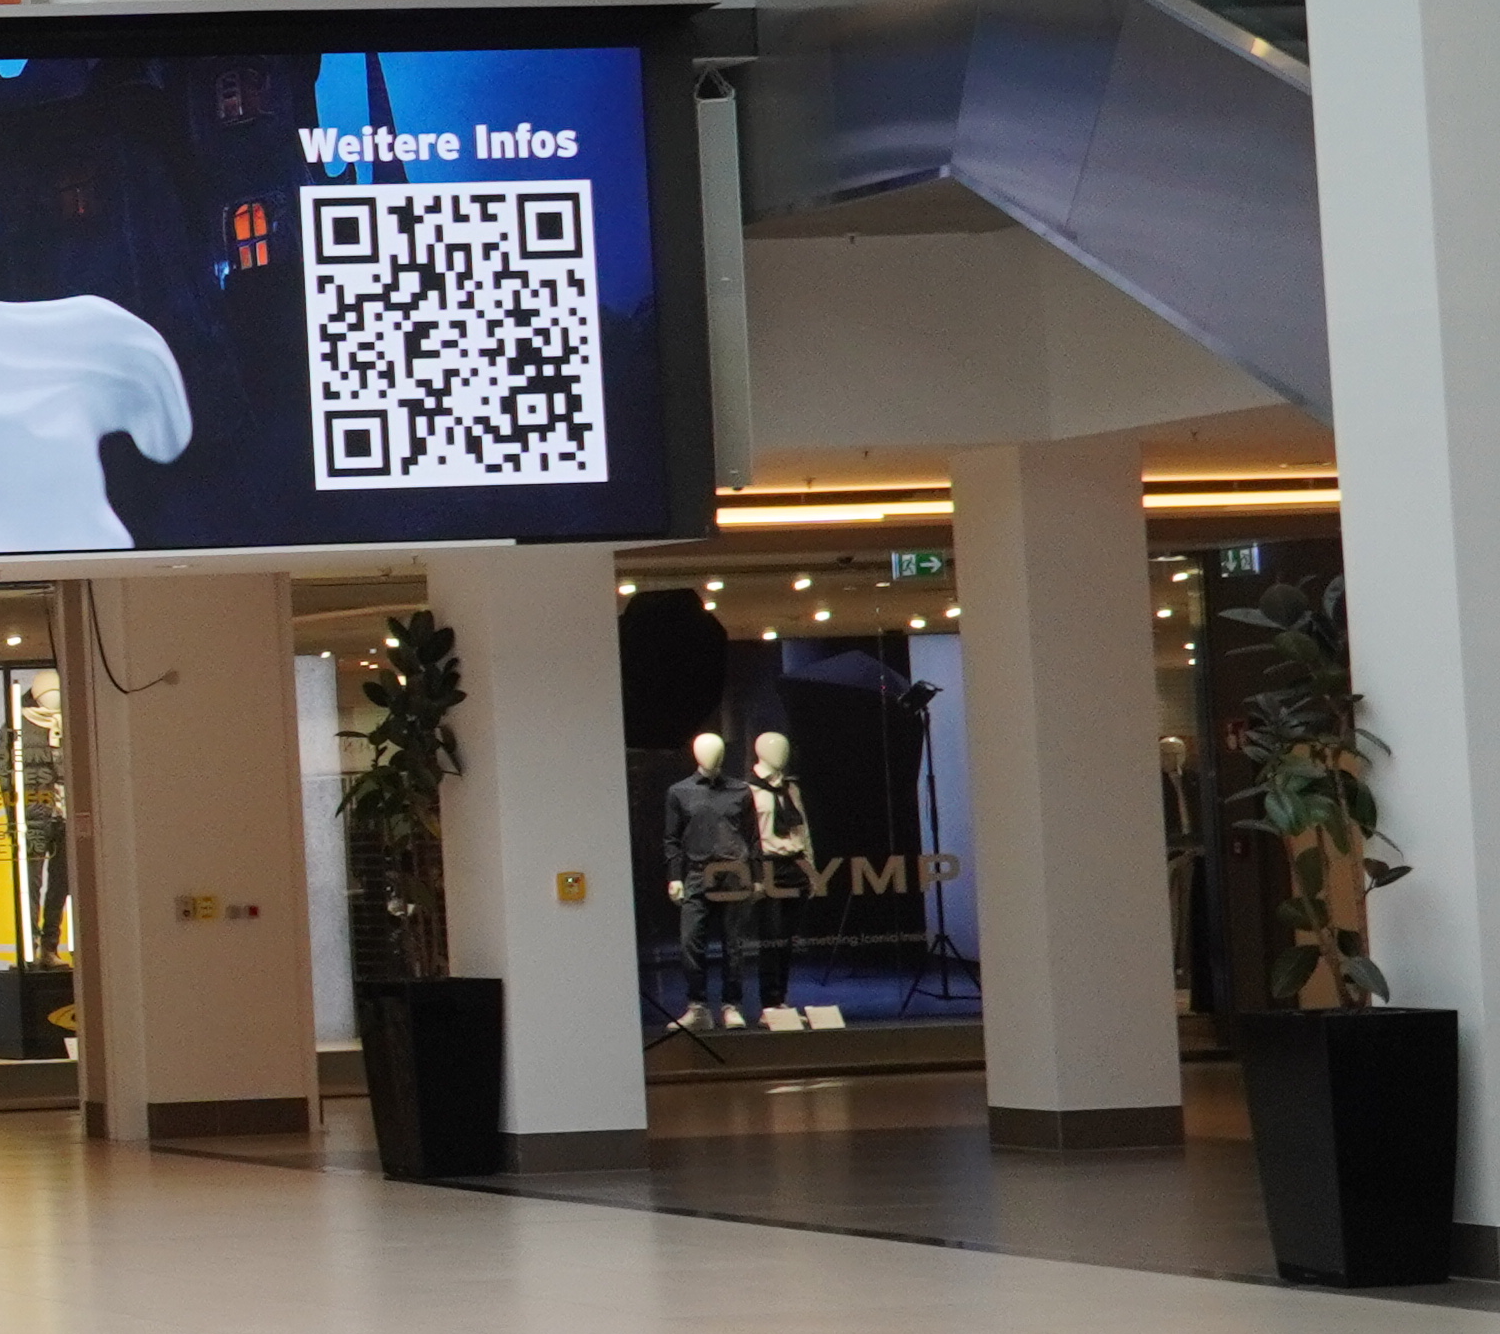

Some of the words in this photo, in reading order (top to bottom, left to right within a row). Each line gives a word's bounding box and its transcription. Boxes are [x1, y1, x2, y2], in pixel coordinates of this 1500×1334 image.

[298, 125, 460, 164] Weitere
[474, 121, 579, 160] Infos
[703, 853, 961, 903] OLYMP
